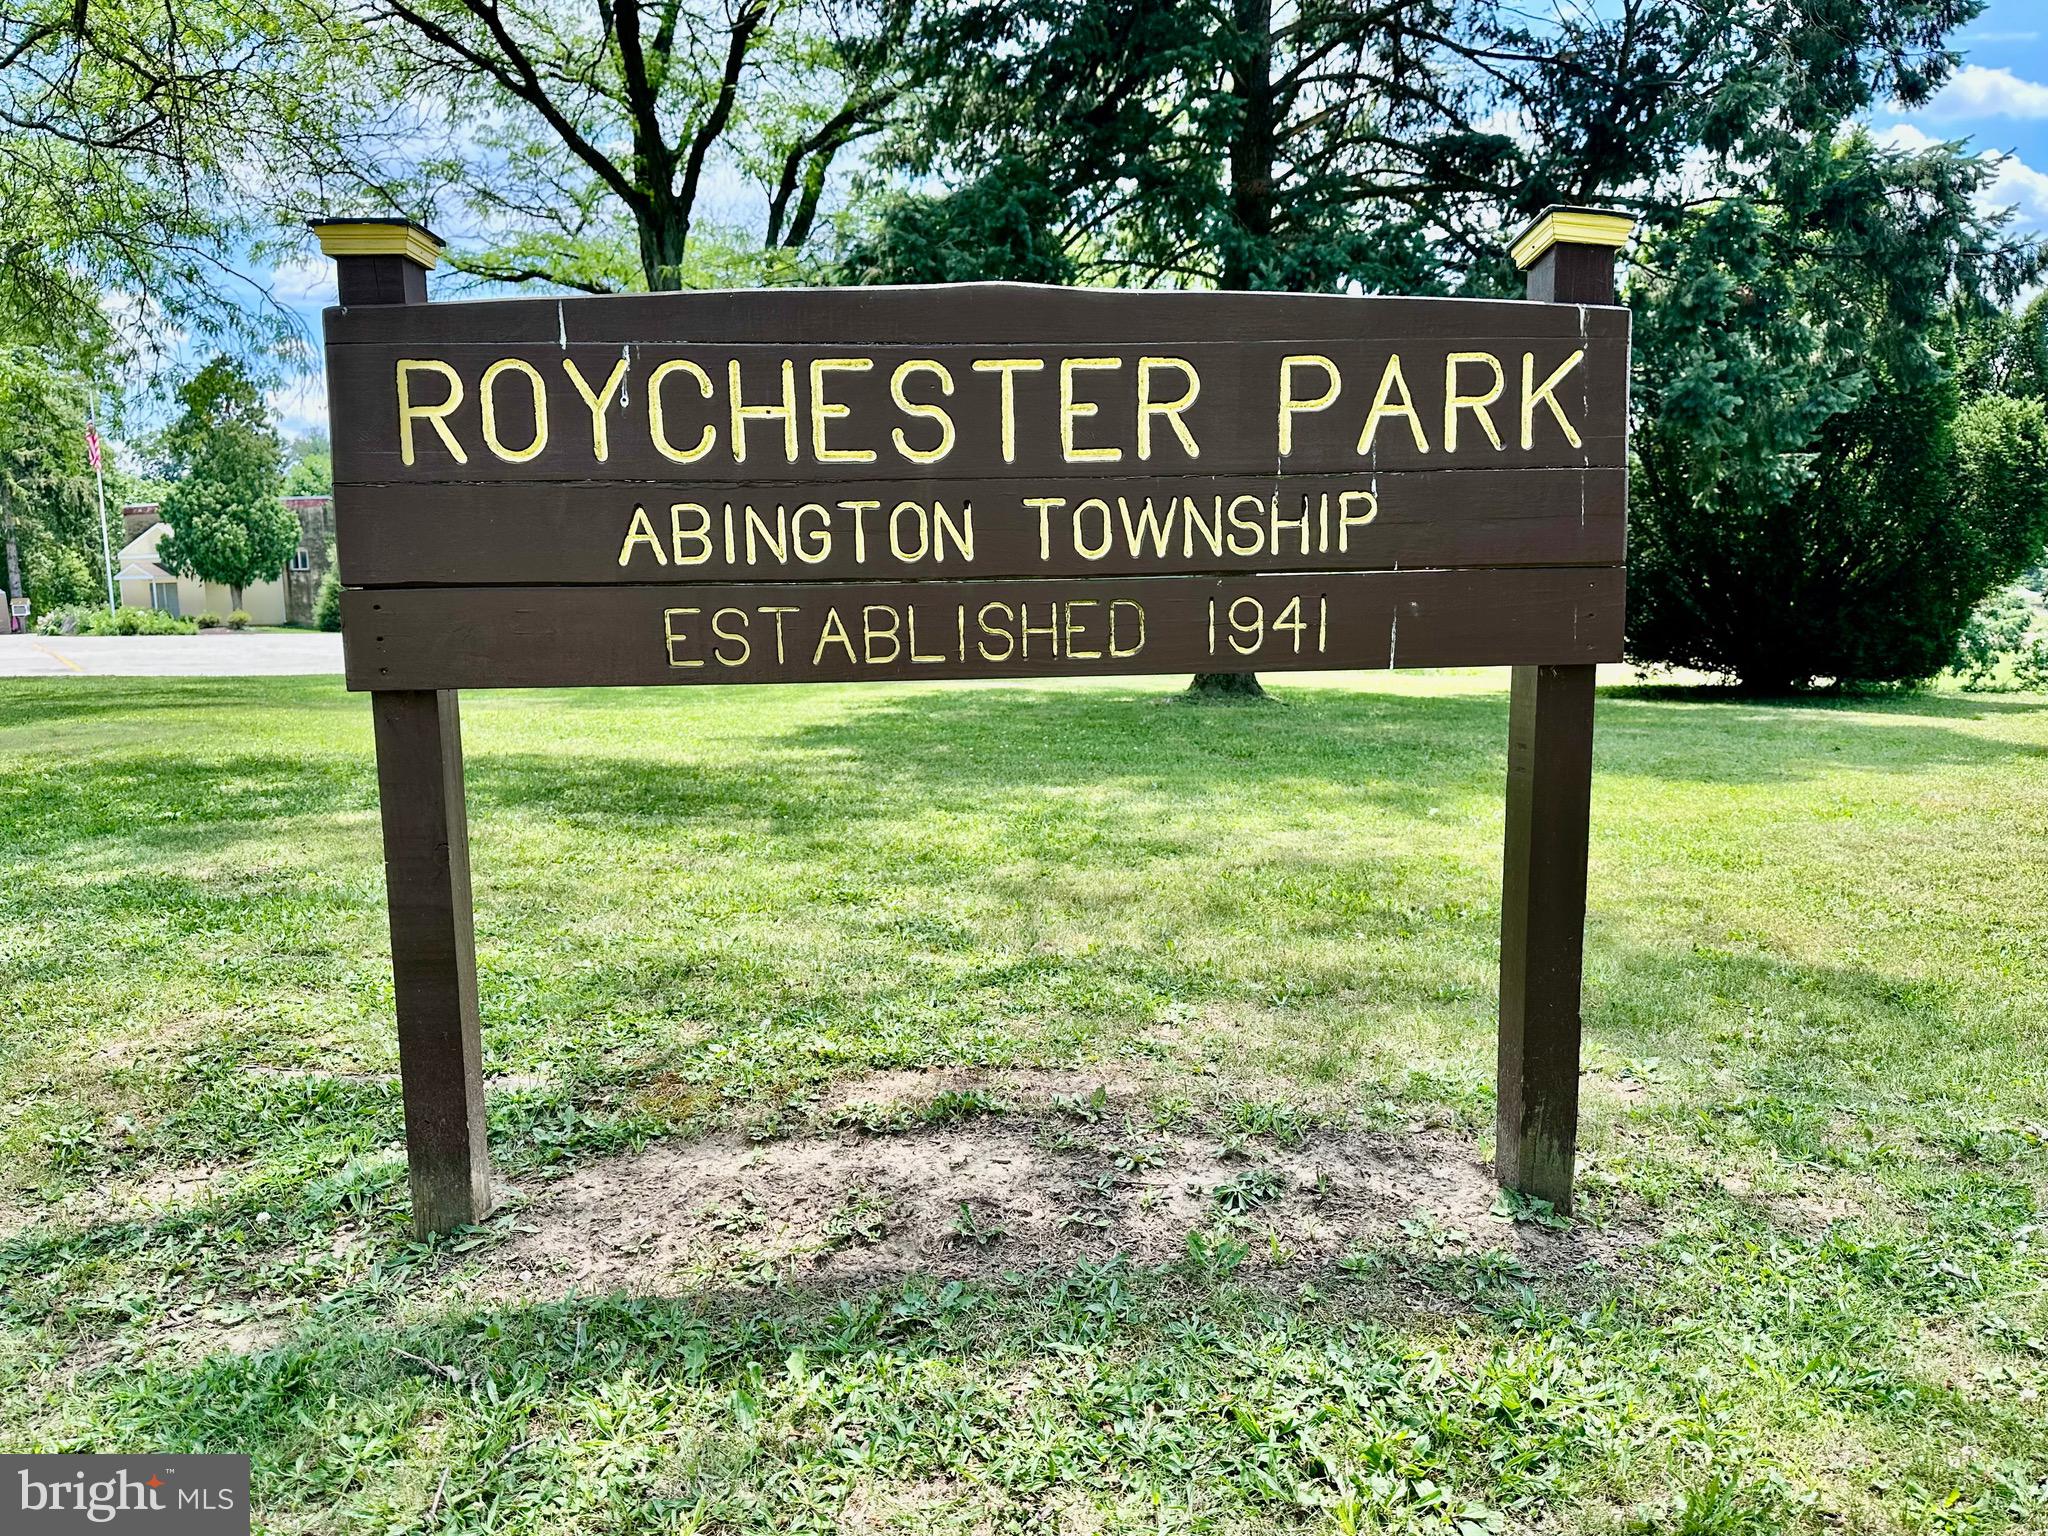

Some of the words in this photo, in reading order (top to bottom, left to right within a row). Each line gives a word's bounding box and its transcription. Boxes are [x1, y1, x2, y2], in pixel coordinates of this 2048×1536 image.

[395, 356, 1201, 467] ROYCHESTER
[1276, 349, 1586, 458] PARK
[617, 499, 976, 568] ABINGTON
[1021, 490, 1380, 563] TOWNSHIP
[663, 600, 1147, 668] ESTABLISHED
[1207, 595, 1328, 657] 1941
